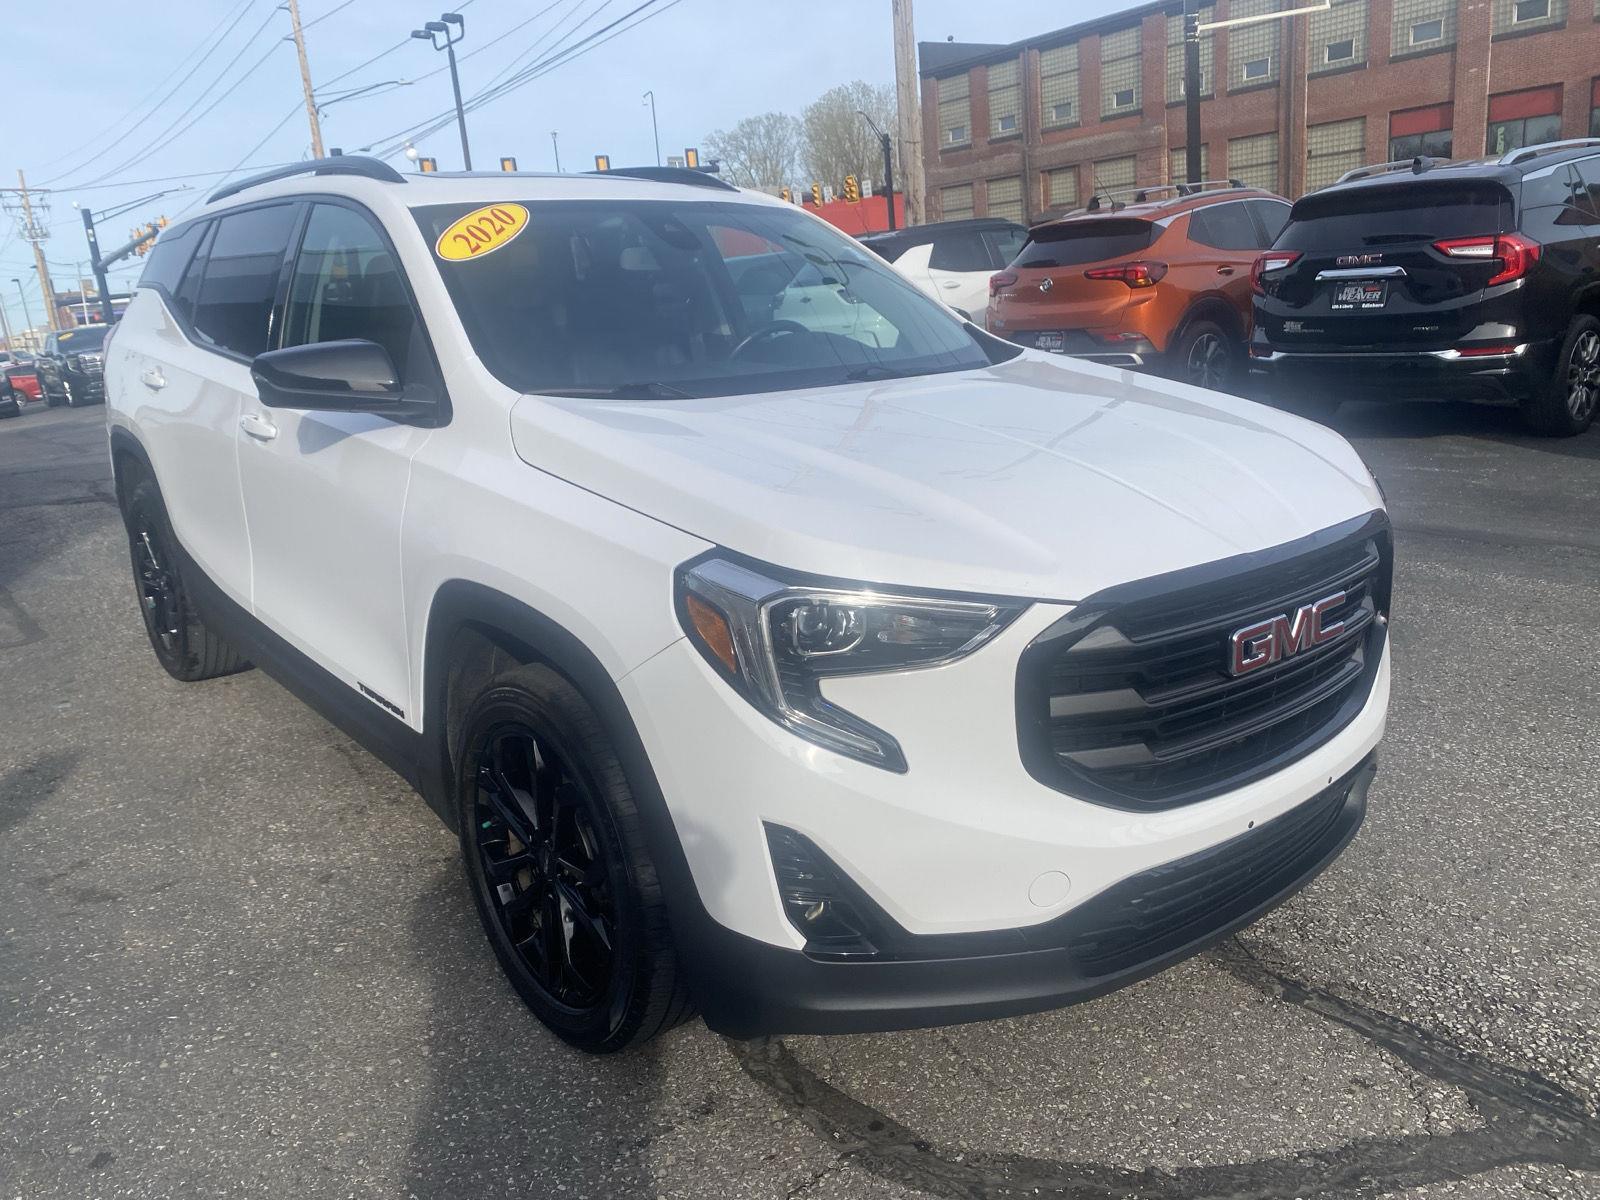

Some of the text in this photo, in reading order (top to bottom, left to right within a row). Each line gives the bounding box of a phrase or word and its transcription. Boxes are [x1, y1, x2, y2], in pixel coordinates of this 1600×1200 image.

[453, 208, 515, 254] 2020
[1336, 253, 1383, 266] GMC
[1338, 291, 1382, 301] WEAVER
[1232, 591, 1345, 676] GMC
